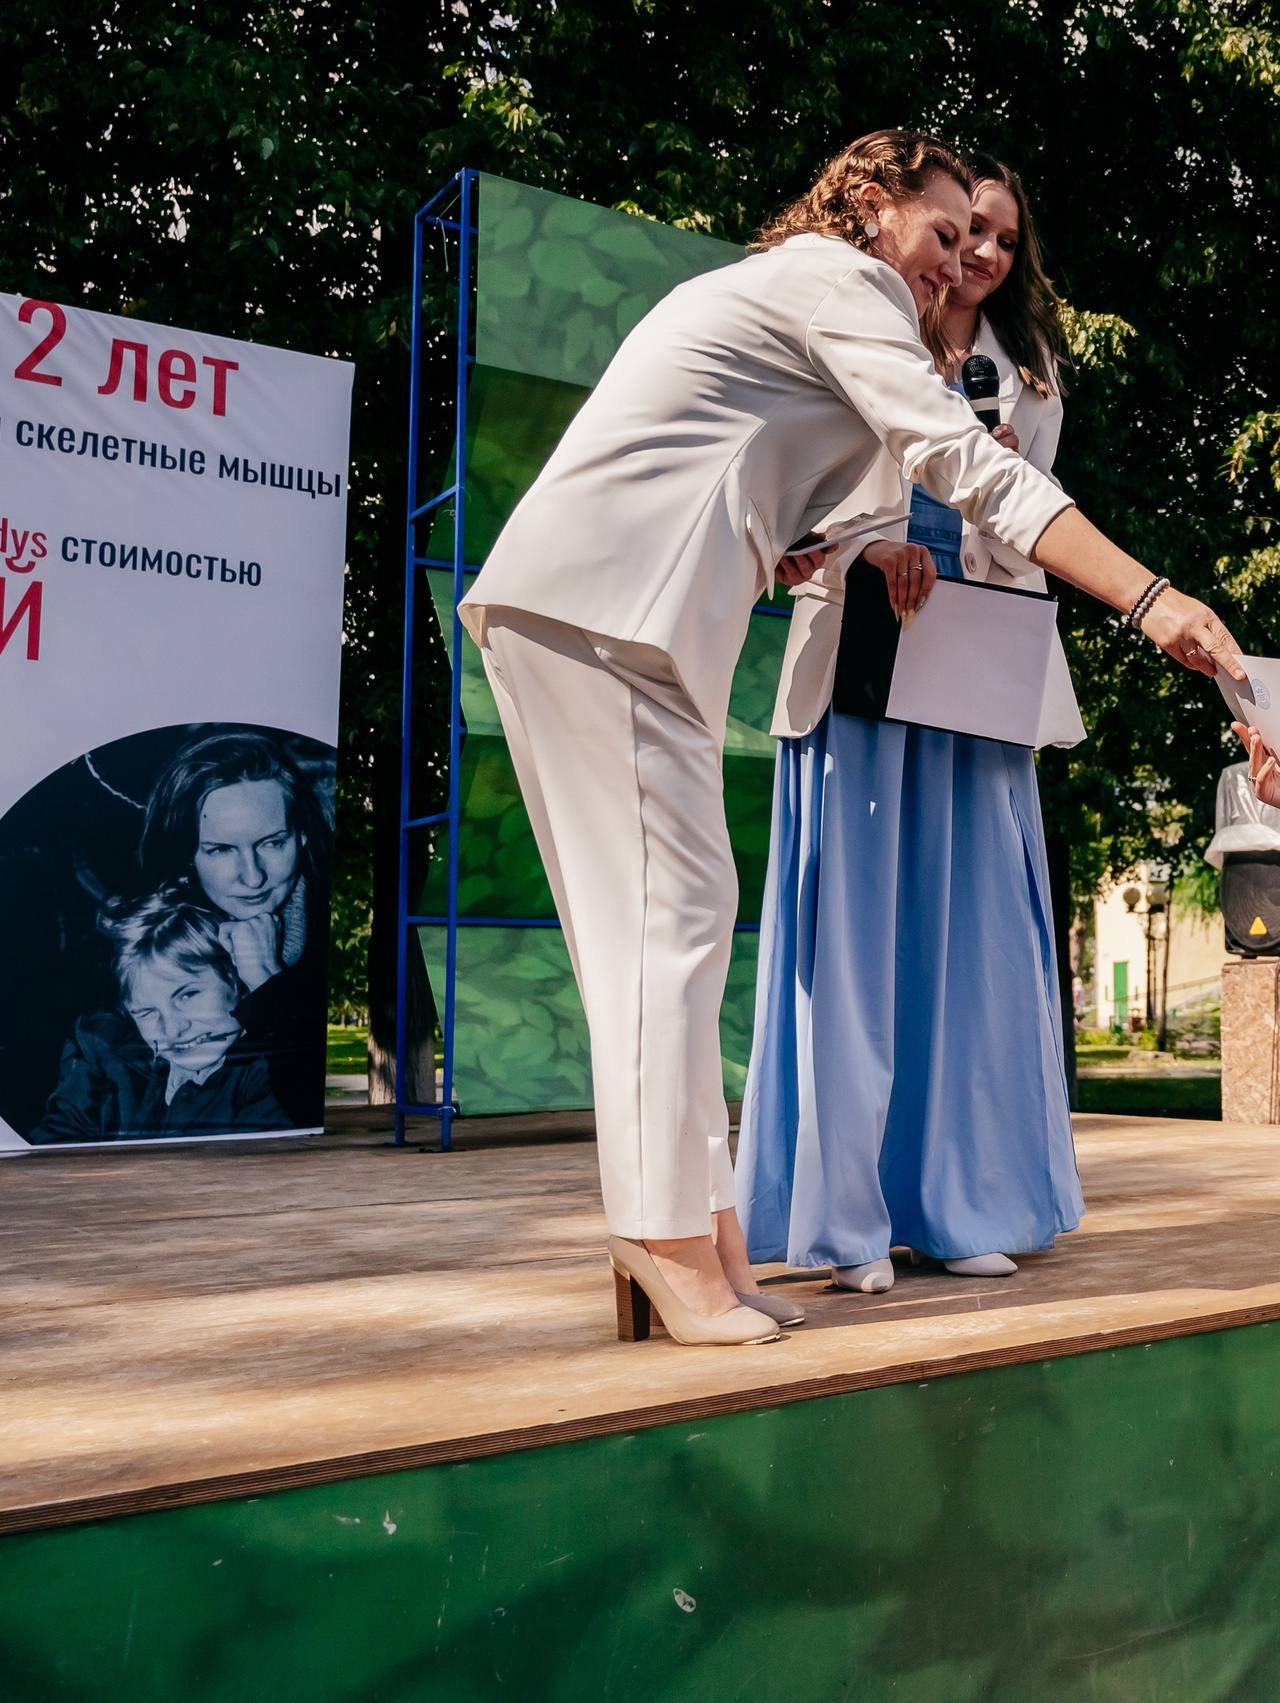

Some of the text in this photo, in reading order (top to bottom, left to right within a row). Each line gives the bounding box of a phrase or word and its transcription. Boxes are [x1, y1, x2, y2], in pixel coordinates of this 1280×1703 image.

[14, 298, 240, 417] 2 лет
[15, 419, 342, 500] скелетные мышцы
[60, 535, 262, 587] стоимостью
